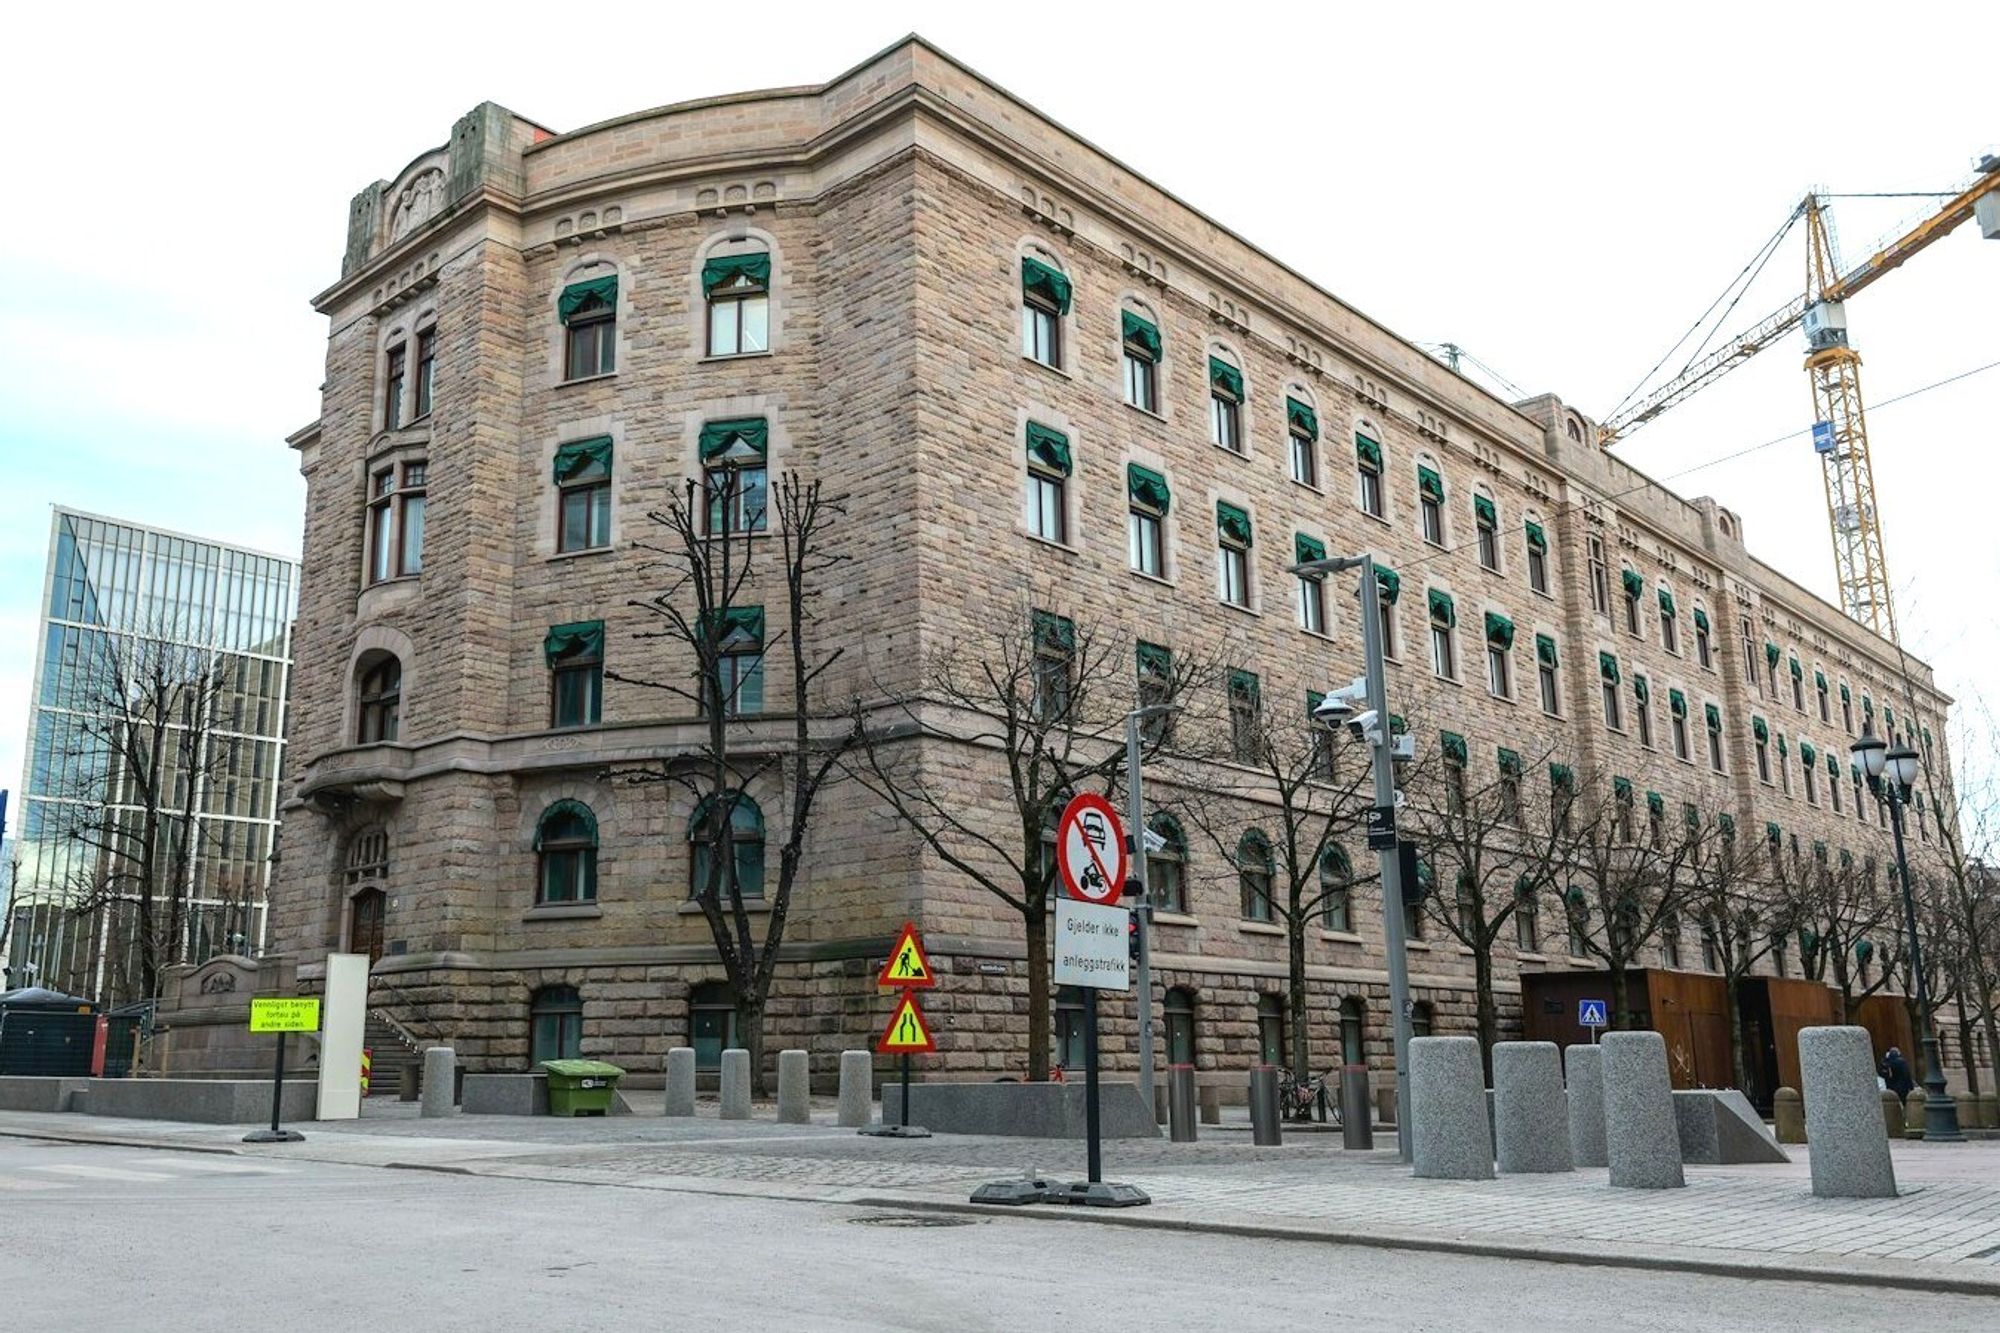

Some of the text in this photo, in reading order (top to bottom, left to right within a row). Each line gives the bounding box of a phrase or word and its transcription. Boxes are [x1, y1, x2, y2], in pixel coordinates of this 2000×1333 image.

[1067, 917, 1119, 936] Gjelder ikke
[1063, 955, 1126, 972] anleggstrafikk
[253, 1001, 315, 1010] Vennligst benytt
[266, 1010, 301, 1019] fortau på
